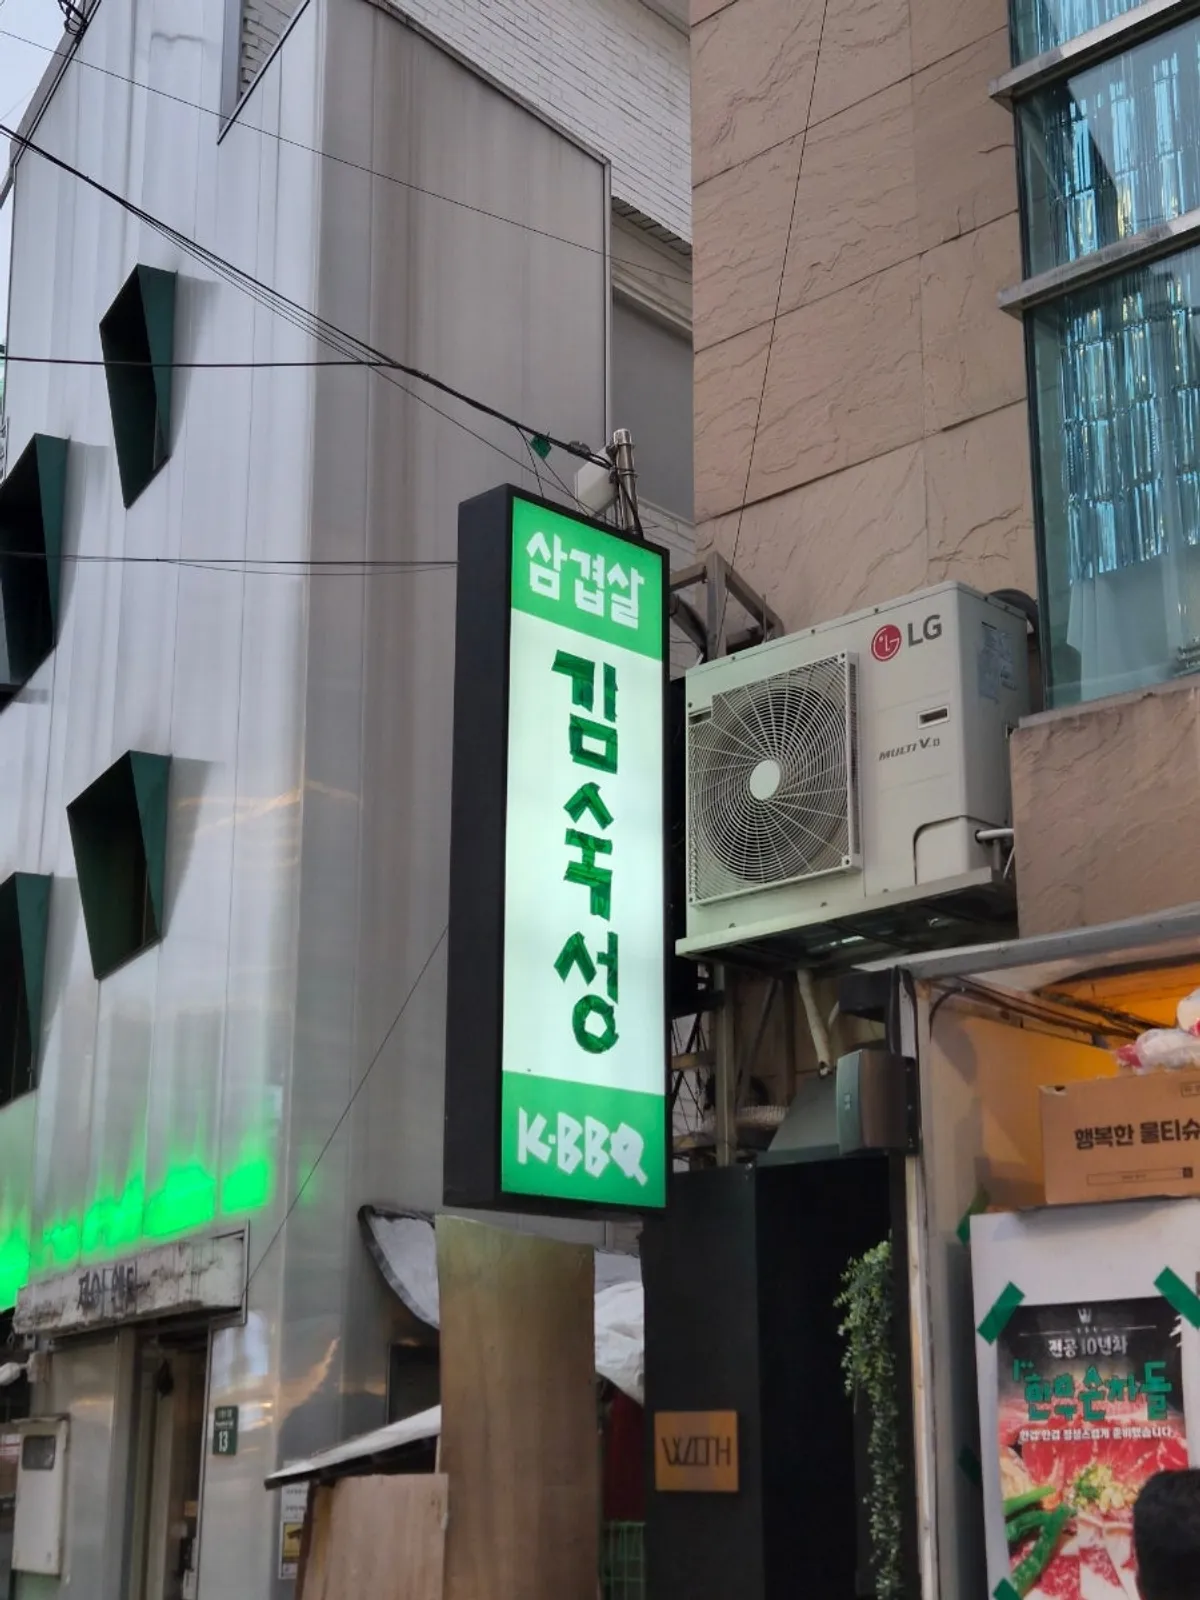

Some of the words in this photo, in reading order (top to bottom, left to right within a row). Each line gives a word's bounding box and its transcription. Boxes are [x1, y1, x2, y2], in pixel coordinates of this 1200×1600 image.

[526, 531, 644, 629] 삼겹살
[907, 614, 943, 648] LG
[879, 742, 917, 761] MULTI
[551, 649, 619, 1054] 김숙성
[1074, 1124, 1135, 1151] 행복한
[1140, 1118, 1200, 1144] 물티슈
[1081, 1334, 1128, 1356] 10년차
[218, 1431, 228, 1452] 13
[661, 1435, 731, 1468] WITH
